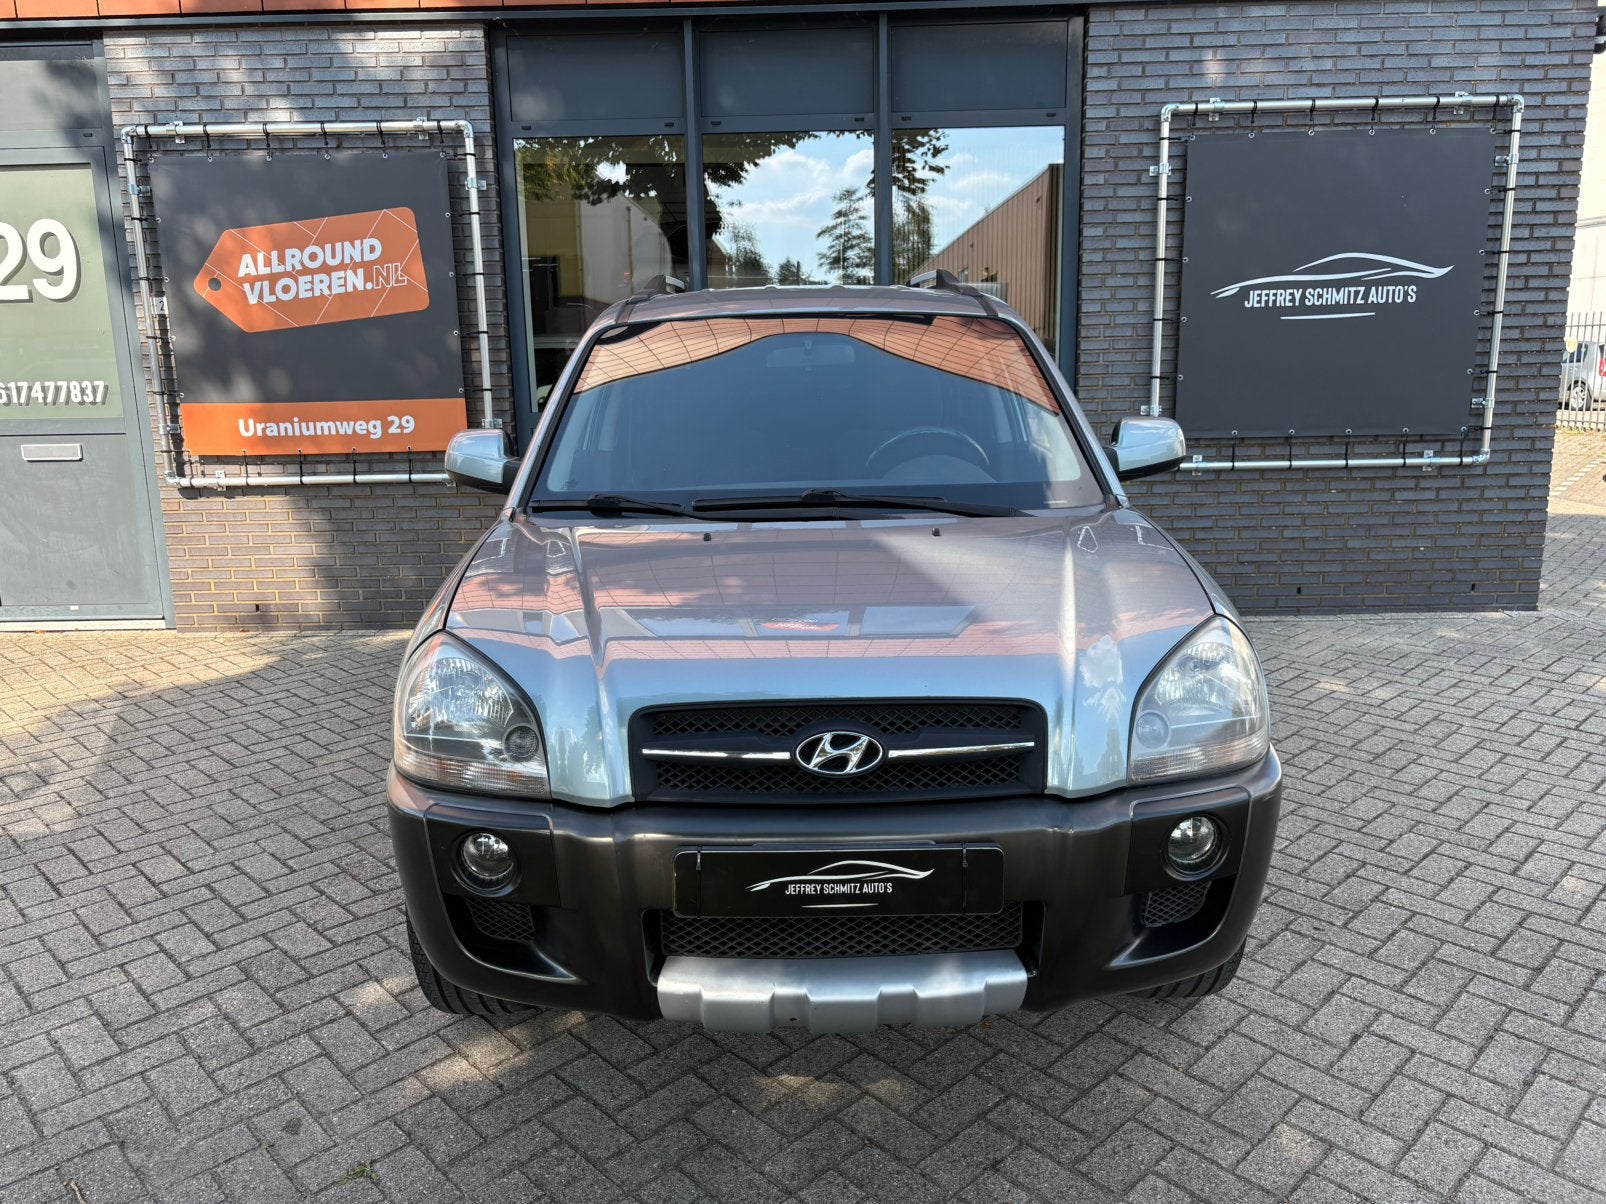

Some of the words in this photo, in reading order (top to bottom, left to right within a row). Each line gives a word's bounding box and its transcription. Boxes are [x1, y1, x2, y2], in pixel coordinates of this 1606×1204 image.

[0, 218, 79, 301] 29
[237, 237, 382, 278] ALLROUND
[242, 262, 408, 305] VLOEREN.NL
[159, 300, 165, 311] 2
[1244, 288, 1303, 308] JEFFREY
[1304, 286, 1366, 306] SCHMITZ
[1367, 285, 1417, 304] AUTO'S
[238, 417, 382, 439] Uraniumweg
[386, 415, 416, 434] 29
[785, 883, 822, 895] JEFFREY
[823, 882, 861, 894] SCHMITZ
[862, 882, 893, 893] AUTO'S
